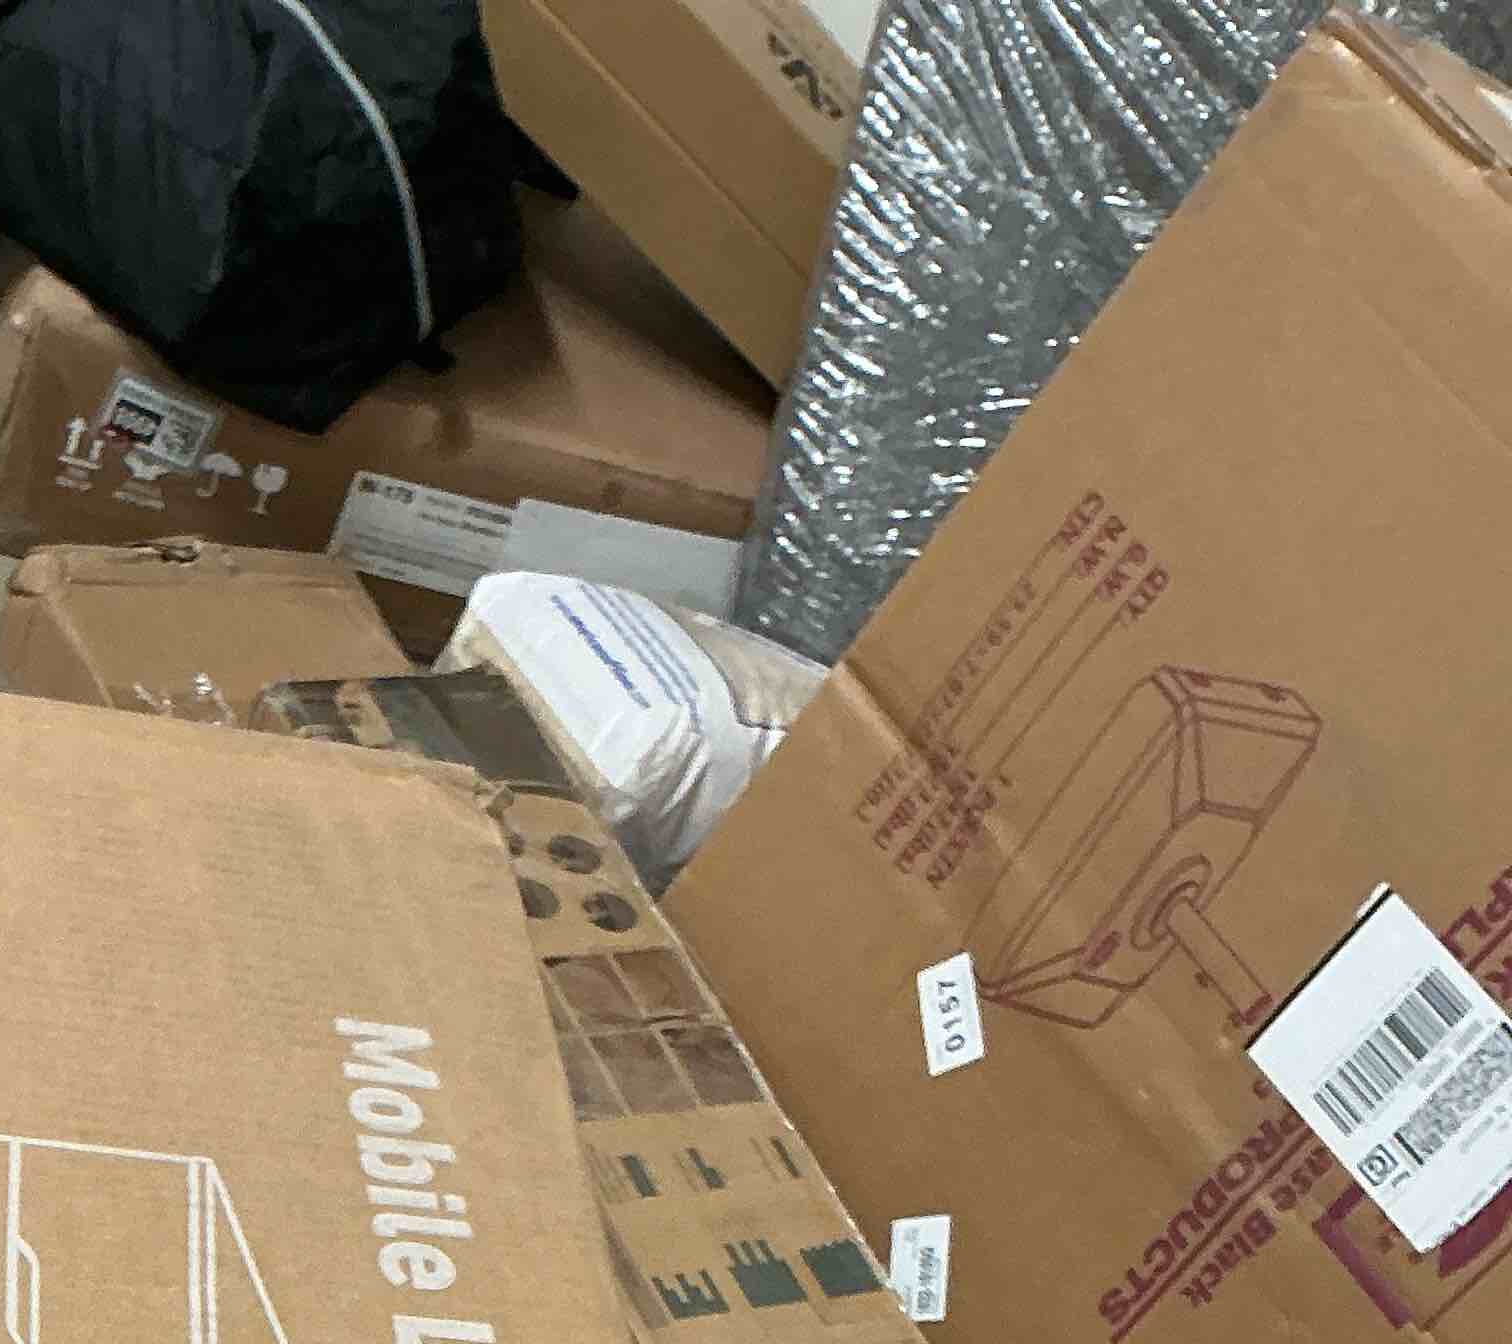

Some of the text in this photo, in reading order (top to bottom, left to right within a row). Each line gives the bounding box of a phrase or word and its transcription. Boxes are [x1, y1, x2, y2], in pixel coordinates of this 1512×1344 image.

[937, 980, 965, 1052] 0157
[335, 1016, 474, 1291] Mobile
[1180, 1148, 1333, 1307] ase Black
